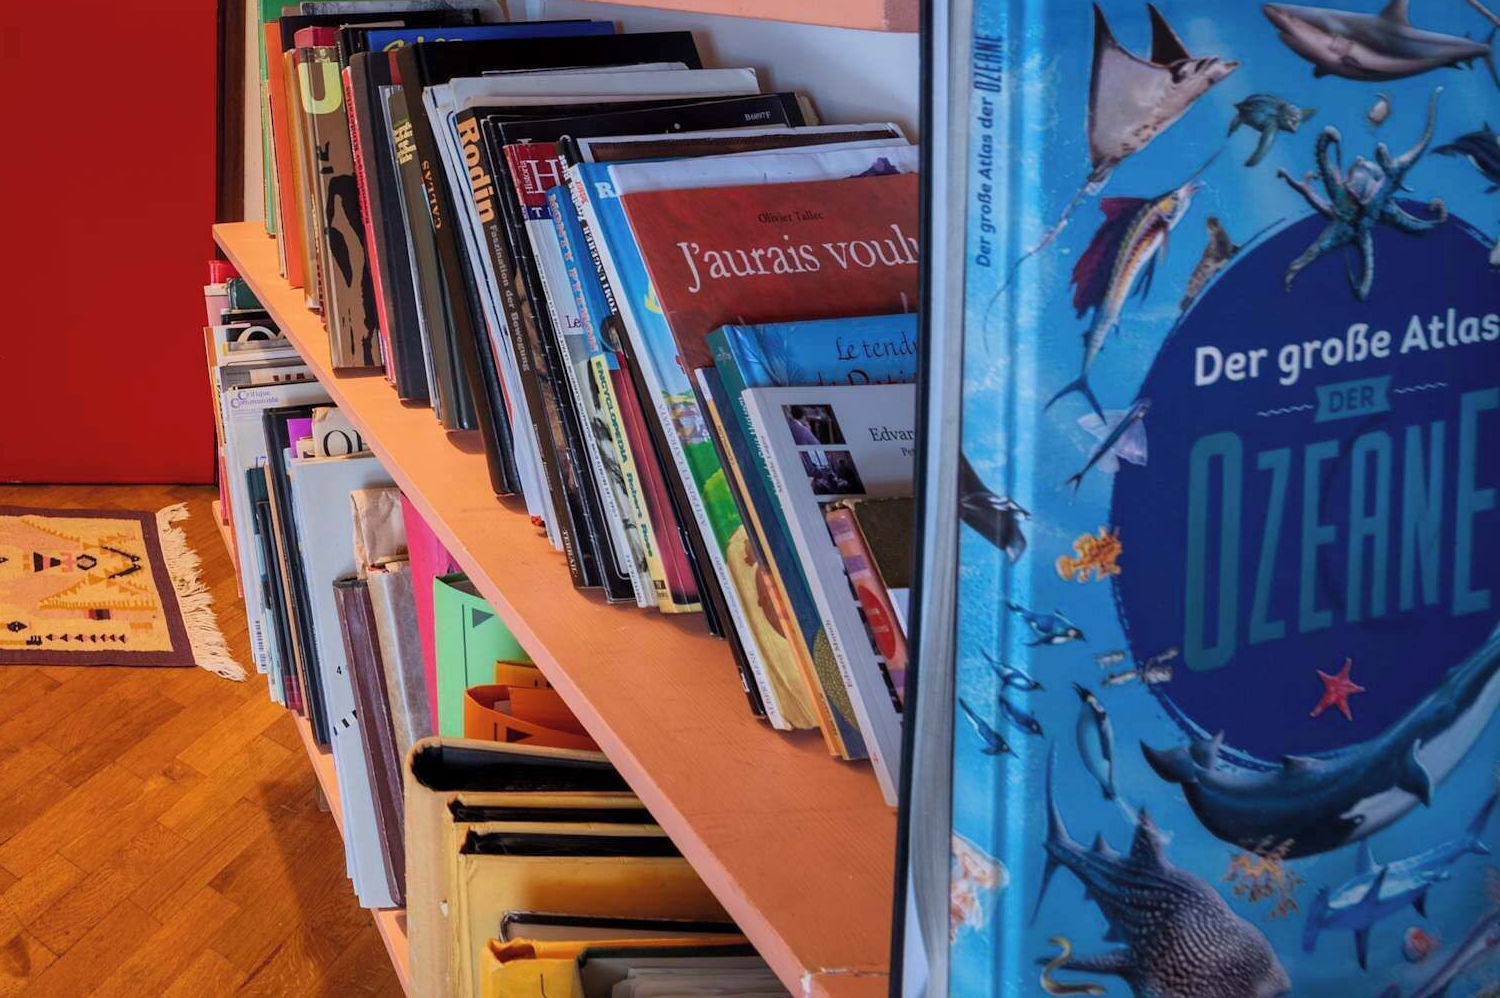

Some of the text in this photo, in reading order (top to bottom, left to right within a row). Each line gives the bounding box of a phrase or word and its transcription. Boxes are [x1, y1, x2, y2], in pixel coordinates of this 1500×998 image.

[456, 117, 495, 224] Rodin
[974, 33, 1003, 268] Der große Atlas der OZEANE
[421, 160, 442, 230] CALLAS
[548, 193, 598, 352] MONTY PYTHON
[583, 227, 605, 283] UNGERER
[676, 234, 821, 293] J'aurais
[489, 224, 530, 372] Faszination der Bewegung
[603, 282, 618, 315] TOMI
[835, 335, 858, 362] Le
[1195, 308, 1500, 387] Der große Atlas
[1328, 385, 1375, 413] DER
[595, 361, 628, 464] ENCYCLOPEDIA
[626, 472, 643, 519] Robert
[1183, 387, 1500, 672] OZEANE
